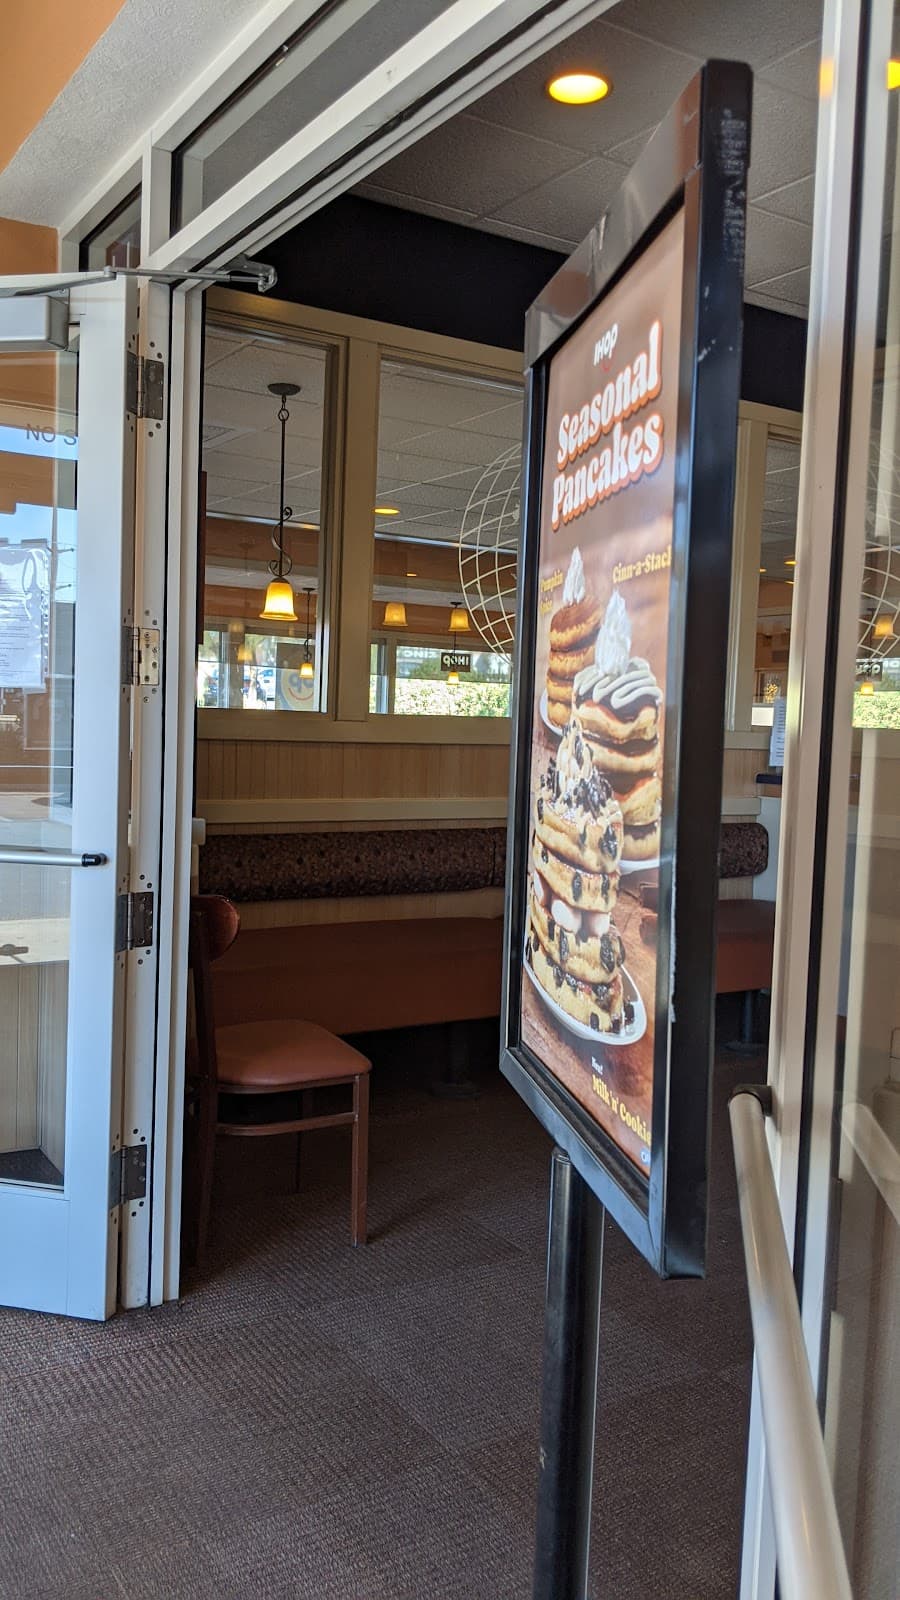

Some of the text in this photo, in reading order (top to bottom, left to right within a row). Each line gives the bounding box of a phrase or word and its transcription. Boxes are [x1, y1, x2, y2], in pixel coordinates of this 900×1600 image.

[594, 323, 618, 366] IHOP
[557, 319, 663, 470] Seasonal
[26, 423, 56, 443] NO
[552, 414, 663, 530] Pancakes
[592, 1074, 610, 1106] Milk
